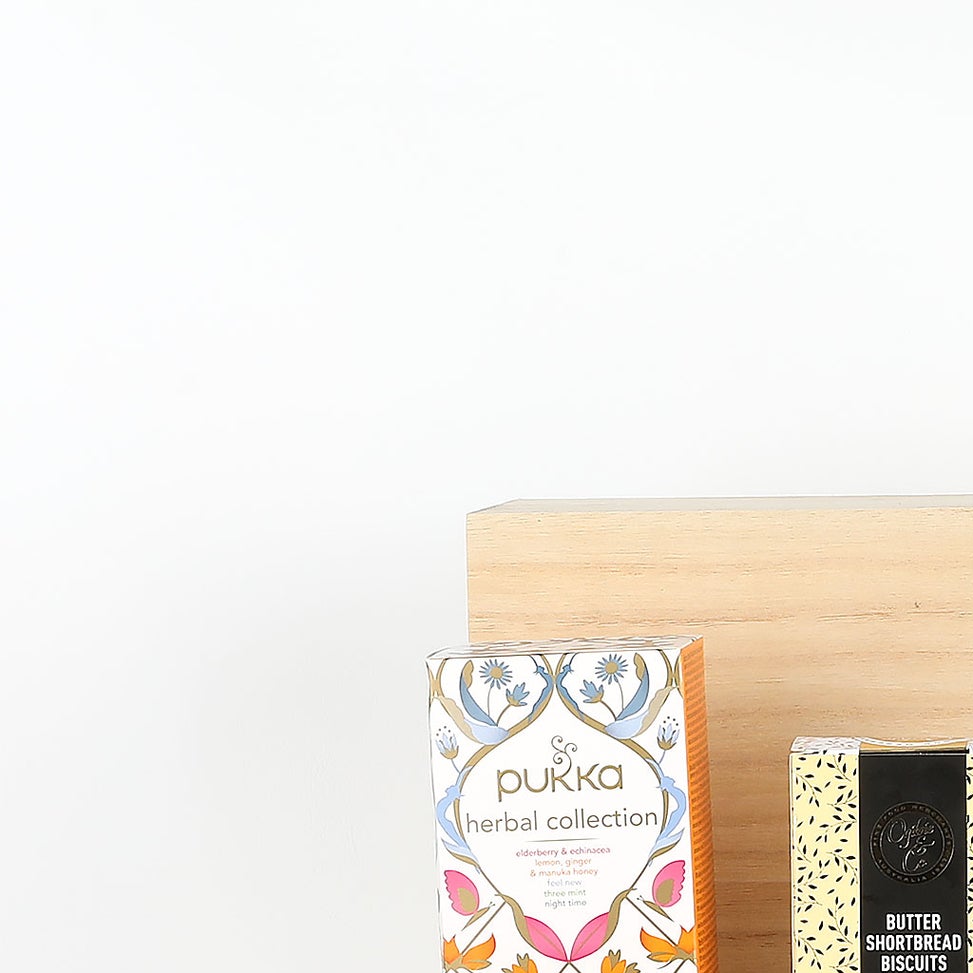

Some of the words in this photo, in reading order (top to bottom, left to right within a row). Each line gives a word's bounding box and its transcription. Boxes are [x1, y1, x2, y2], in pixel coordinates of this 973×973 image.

[497, 744, 623, 802] pukka
[466, 810, 537, 833] herbal
[547, 808, 657, 830] collection
[516, 848, 559, 857] elderberry
[561, 847, 567, 855] &
[570, 846, 611, 855] echinacea
[535, 859, 563, 867] lemon,
[565, 858, 591, 867] ginger
[530, 869, 536, 877] &
[573, 868, 598, 876] honey
[547, 879, 562, 887] feel
[545, 900, 565, 909] night
[568, 899, 587, 907] time
[886, 913, 942, 931] BUTTER
[866, 934, 962, 951] SHORTBREAD
[881, 954, 948, 972] BISCUITS
